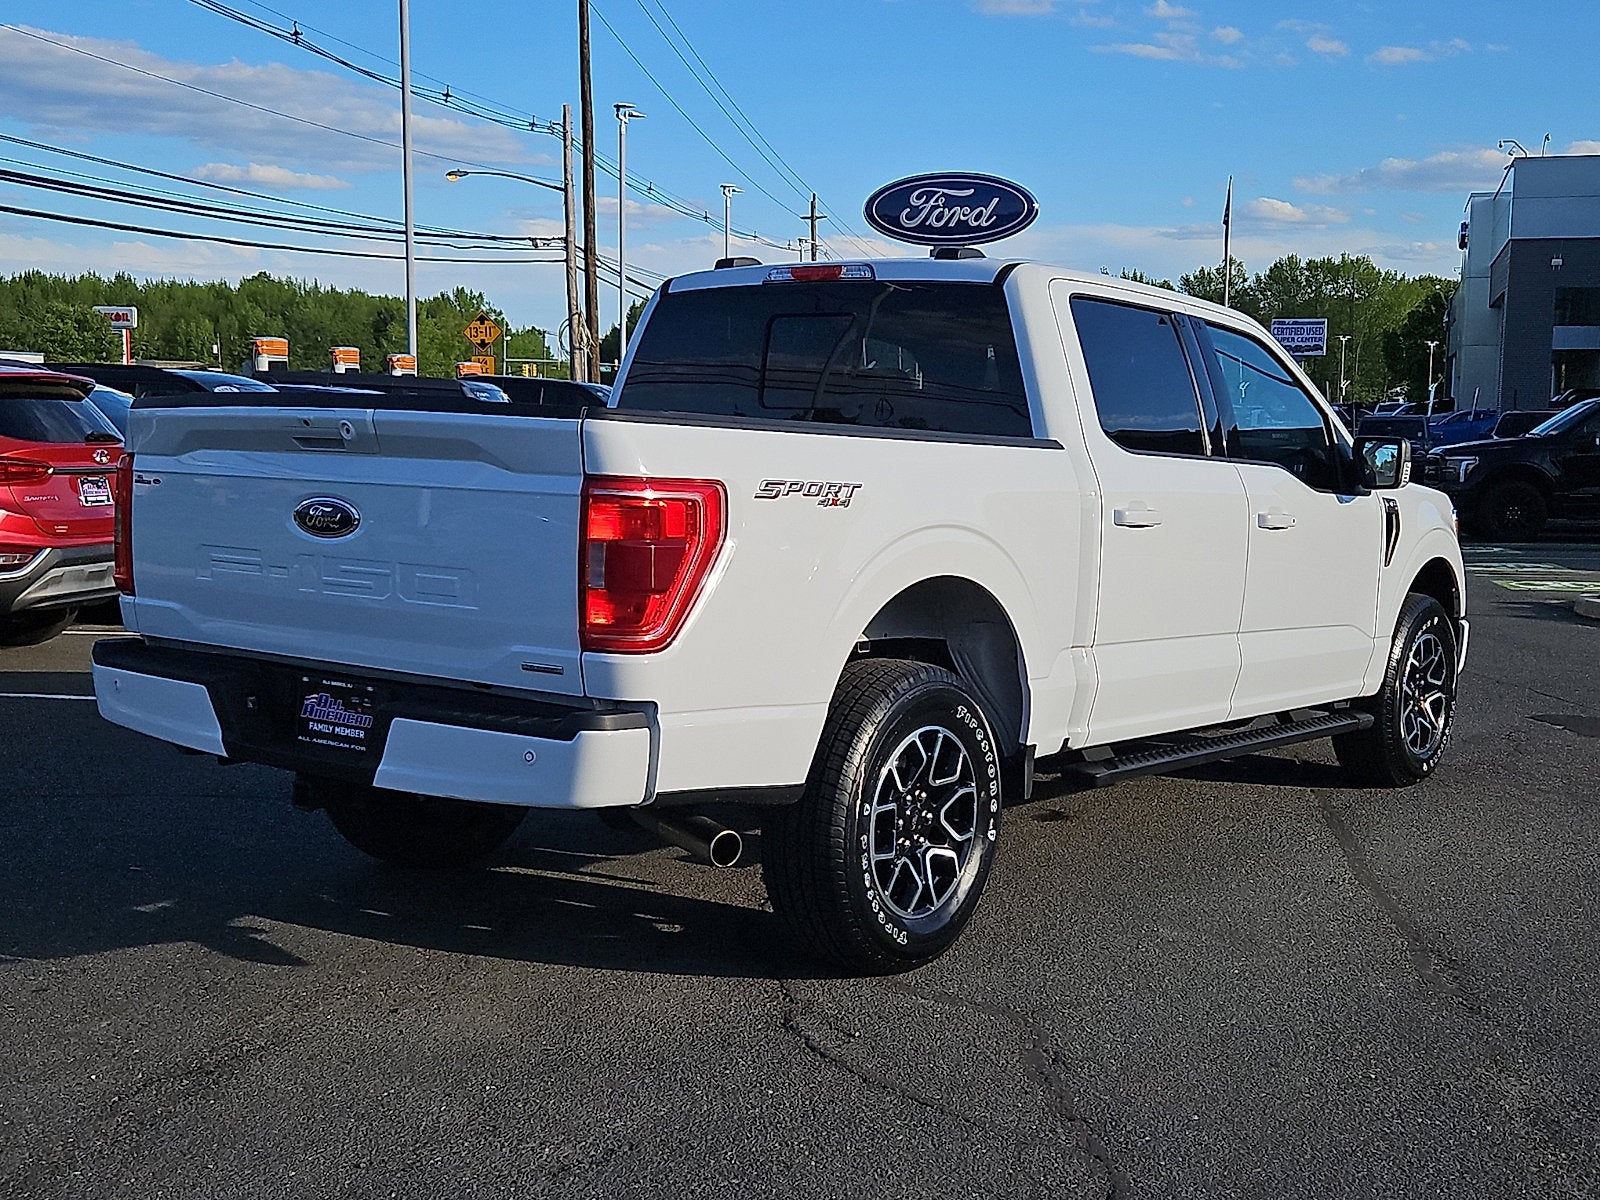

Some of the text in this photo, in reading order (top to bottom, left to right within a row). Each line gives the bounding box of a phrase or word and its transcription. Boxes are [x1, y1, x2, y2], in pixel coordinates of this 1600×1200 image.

[901, 187, 999, 227] Ford
[1272, 326, 1324, 336] CERTIFIED USED
[753, 479, 863, 499] SPORT
[306, 504, 340, 529] Ford
[195, 543, 480, 610] F-150
[308, 721, 365, 739] FAMILY MEMBER
[312, 738, 349, 748] AMERICAN
[955, 704, 1000, 813] Firestone
